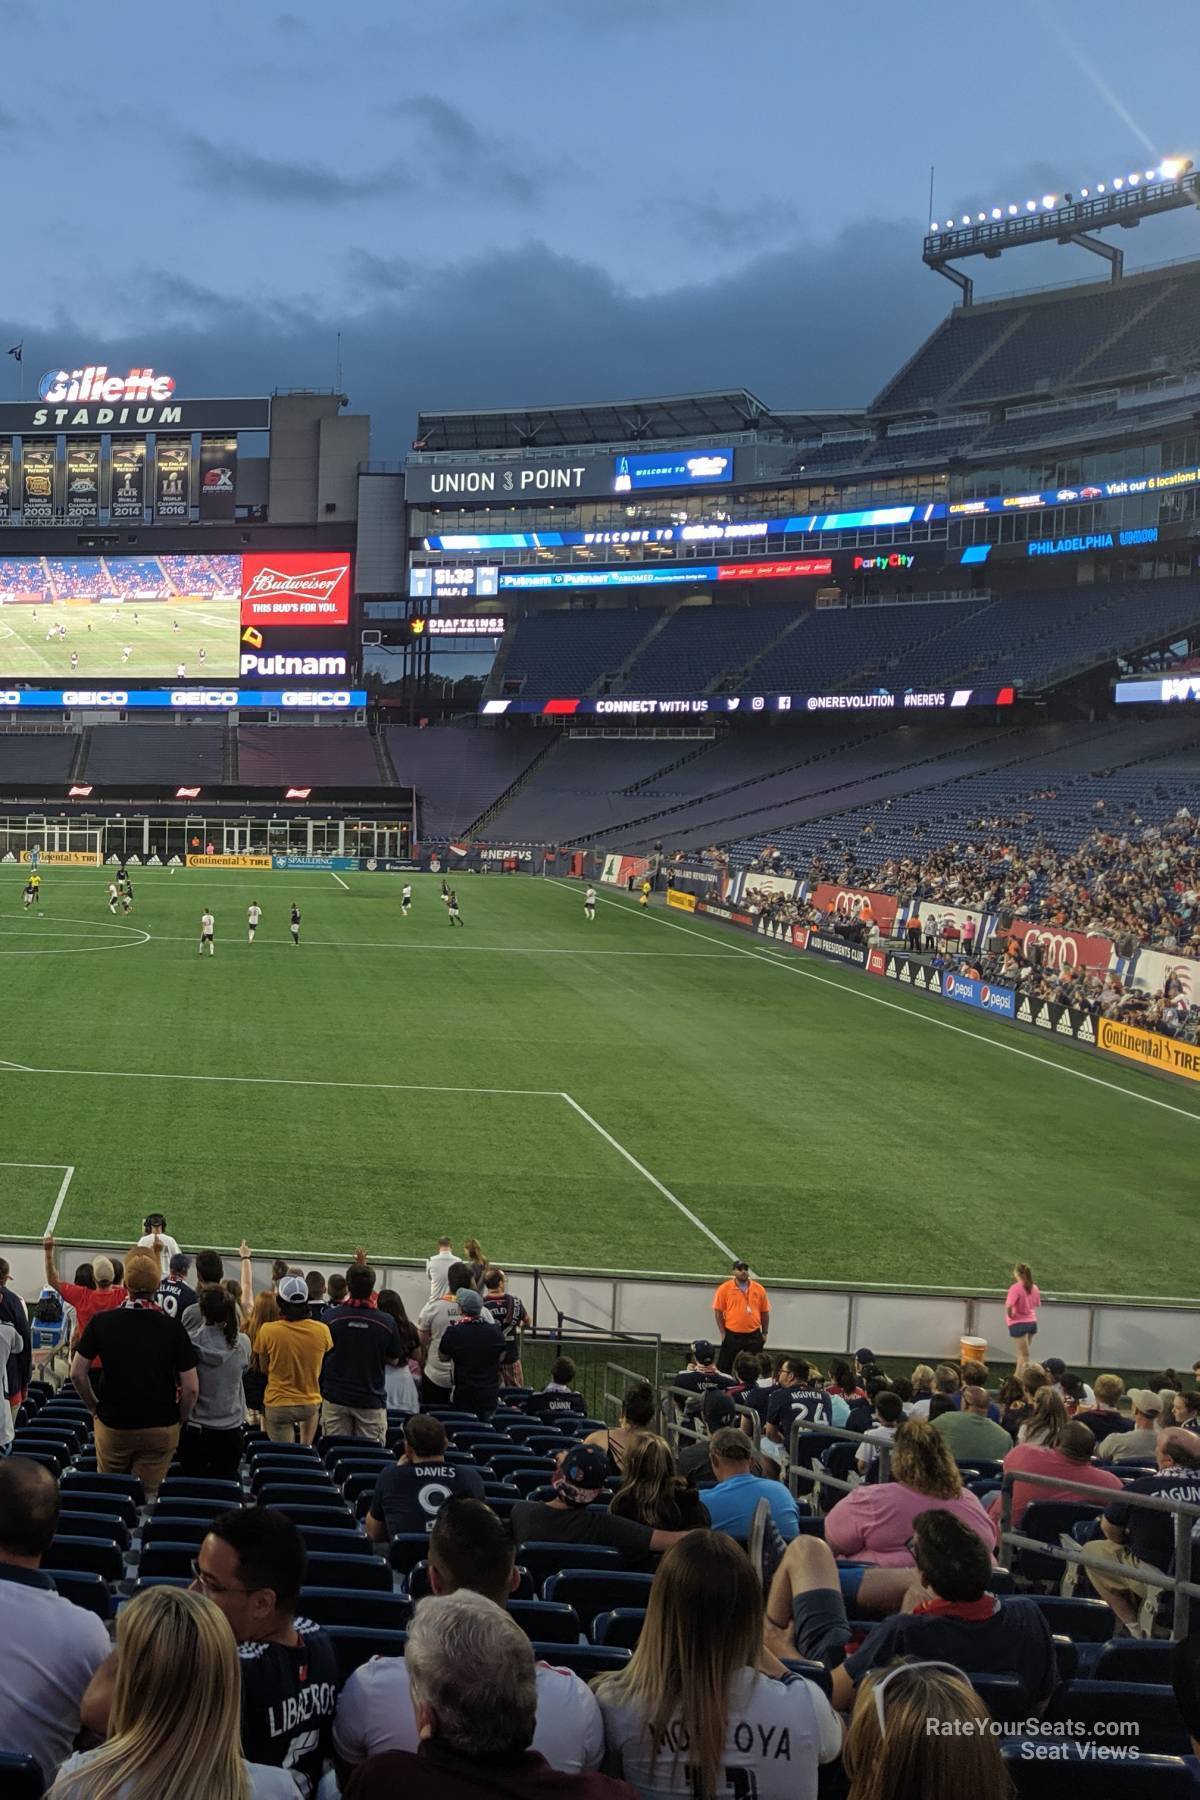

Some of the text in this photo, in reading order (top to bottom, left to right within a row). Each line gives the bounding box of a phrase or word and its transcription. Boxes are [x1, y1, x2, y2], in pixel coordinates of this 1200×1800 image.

[40, 367, 176, 402] Gillette
[32, 406, 183, 427] STADIUM
[431, 468, 586, 493] UNION POINT
[1106, 472, 1196, 494] Visit our 6 locations
[24, 508, 52, 516] 2003
[68, 508, 96, 516] 2004
[114, 508, 139, 516] 2014
[160, 507, 184, 515] 2016
[585, 530, 649, 543] WELCOME
[656, 529, 673, 540] TO
[1029, 528, 1158, 556] PHILADELPHIA UNION
[252, 574, 337, 591] Budweiser
[505, 575, 551, 586] Putnam
[461, 587, 468, 596] 2
[252, 603, 338, 613] THIS BUD'S FOR YOU.
[429, 618, 504, 628] DRAFTKINGS
[241, 654, 346, 675] Putnam
[62, 691, 128, 705] GEICO
[171, 691, 238, 705] GEICO
[282, 691, 350, 706] GEICO
[596, 693, 945, 712] CONNECT WITH US @NEREVOLUTION #NEREVS
[189, 855, 240, 867] Continental
[810, 936, 864, 963] AUDI PRESIDENTS CLUB
[955, 982, 973, 998] pepsi
[990, 993, 1011, 1009] pepsi
[1017, 1011, 1033, 1023] adidas
[1035, 1017, 1052, 1030] adidas
[1056, 1023, 1073, 1036] adidas
[1077, 1030, 1096, 1043] adidas
[1102, 1022, 1162, 1060] Continental
[791, 1391, 822, 1400] NGUYEN
[791, 1402, 830, 1426] 24
[415, 1467, 456, 1478] DAVIES
[648, 1721, 791, 1761] MOOYA
